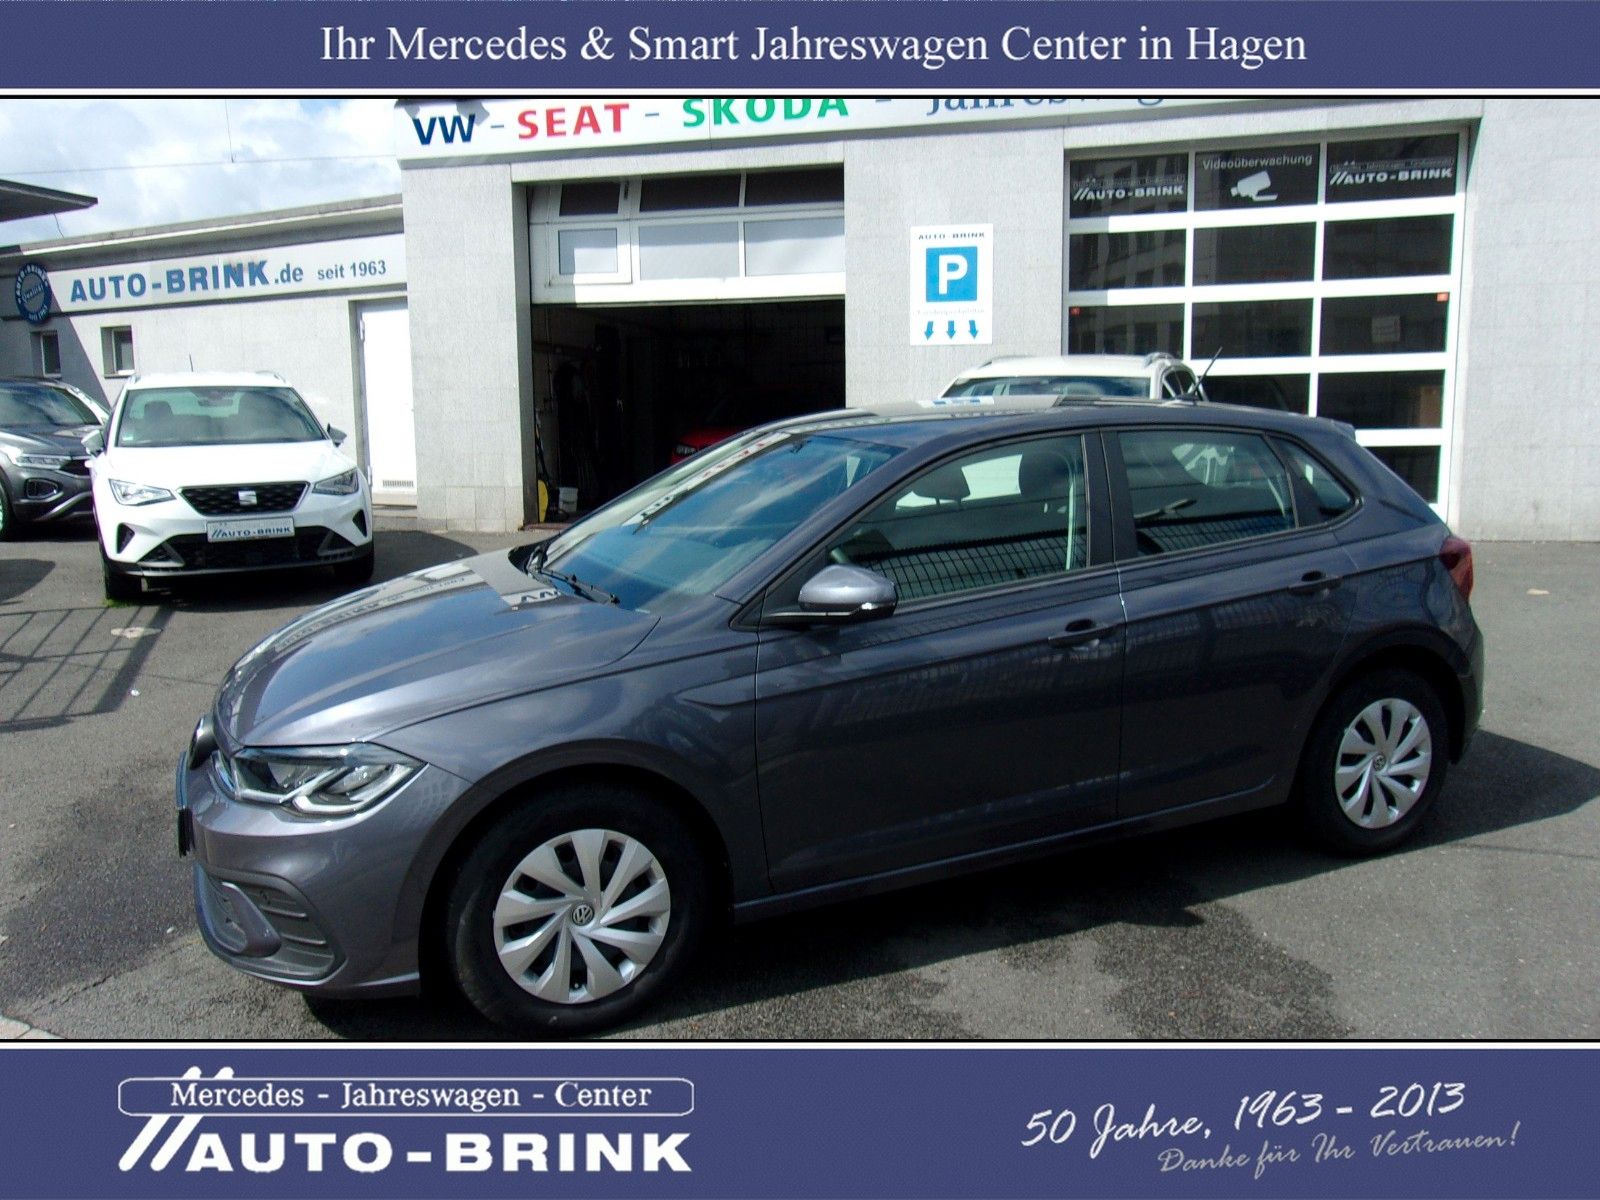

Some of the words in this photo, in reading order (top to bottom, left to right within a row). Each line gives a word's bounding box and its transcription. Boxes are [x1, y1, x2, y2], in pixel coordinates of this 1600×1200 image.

[412, 114, 476, 146] VW
[517, 102, 630, 140] SEAT
[1202, 154, 1313, 170] Videoüberwachung
[317, 265, 345, 281] seit
[349, 259, 387, 278] 1963
[938, 254, 968, 295] P
